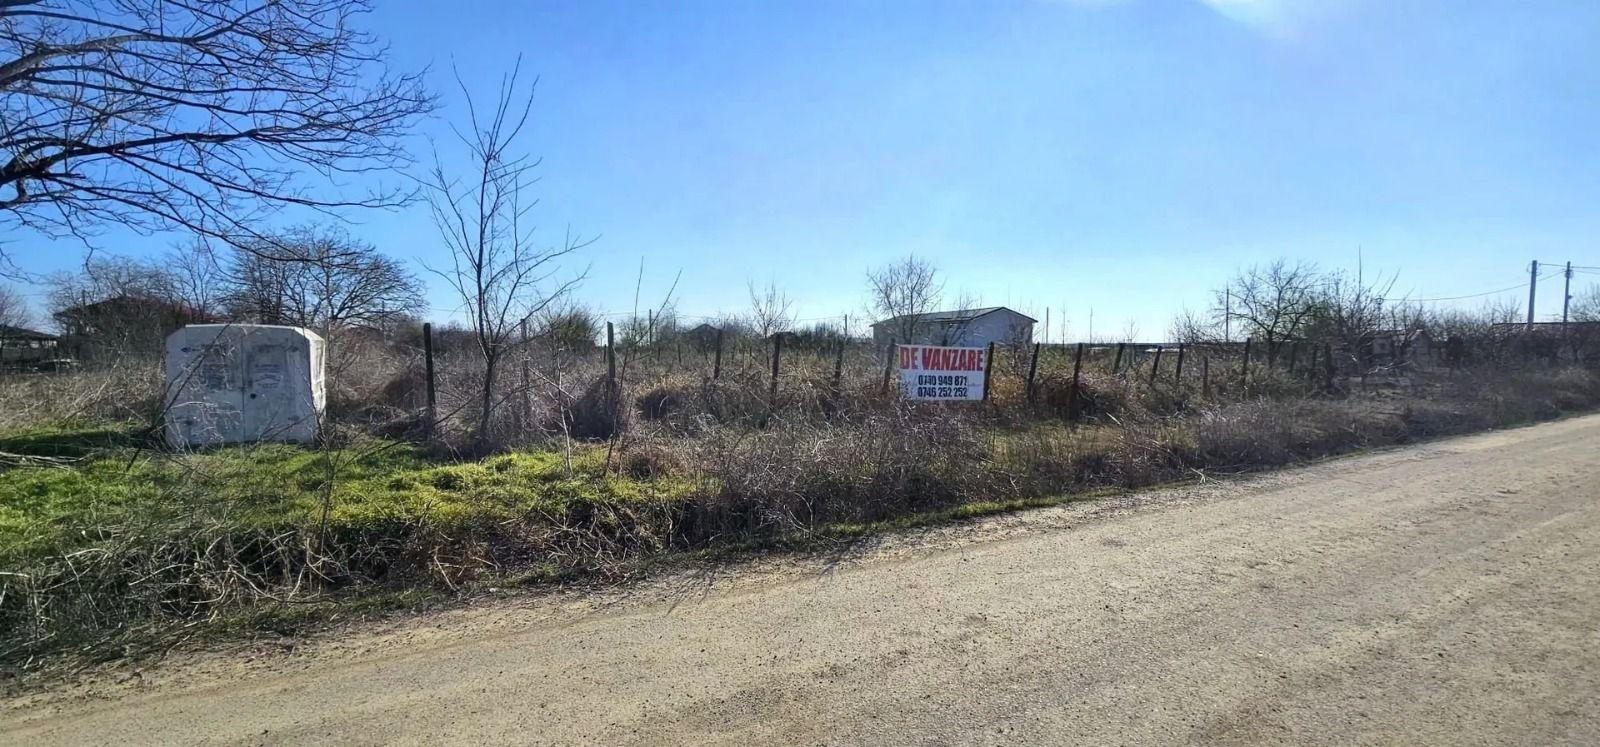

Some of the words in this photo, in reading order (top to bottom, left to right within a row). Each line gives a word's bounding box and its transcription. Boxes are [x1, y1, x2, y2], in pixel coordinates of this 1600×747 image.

[900, 347, 918, 370] DE
[922, 348, 983, 371] VANZARE
[954, 376, 967, 387] 871
[938, 387, 952, 397] 252
